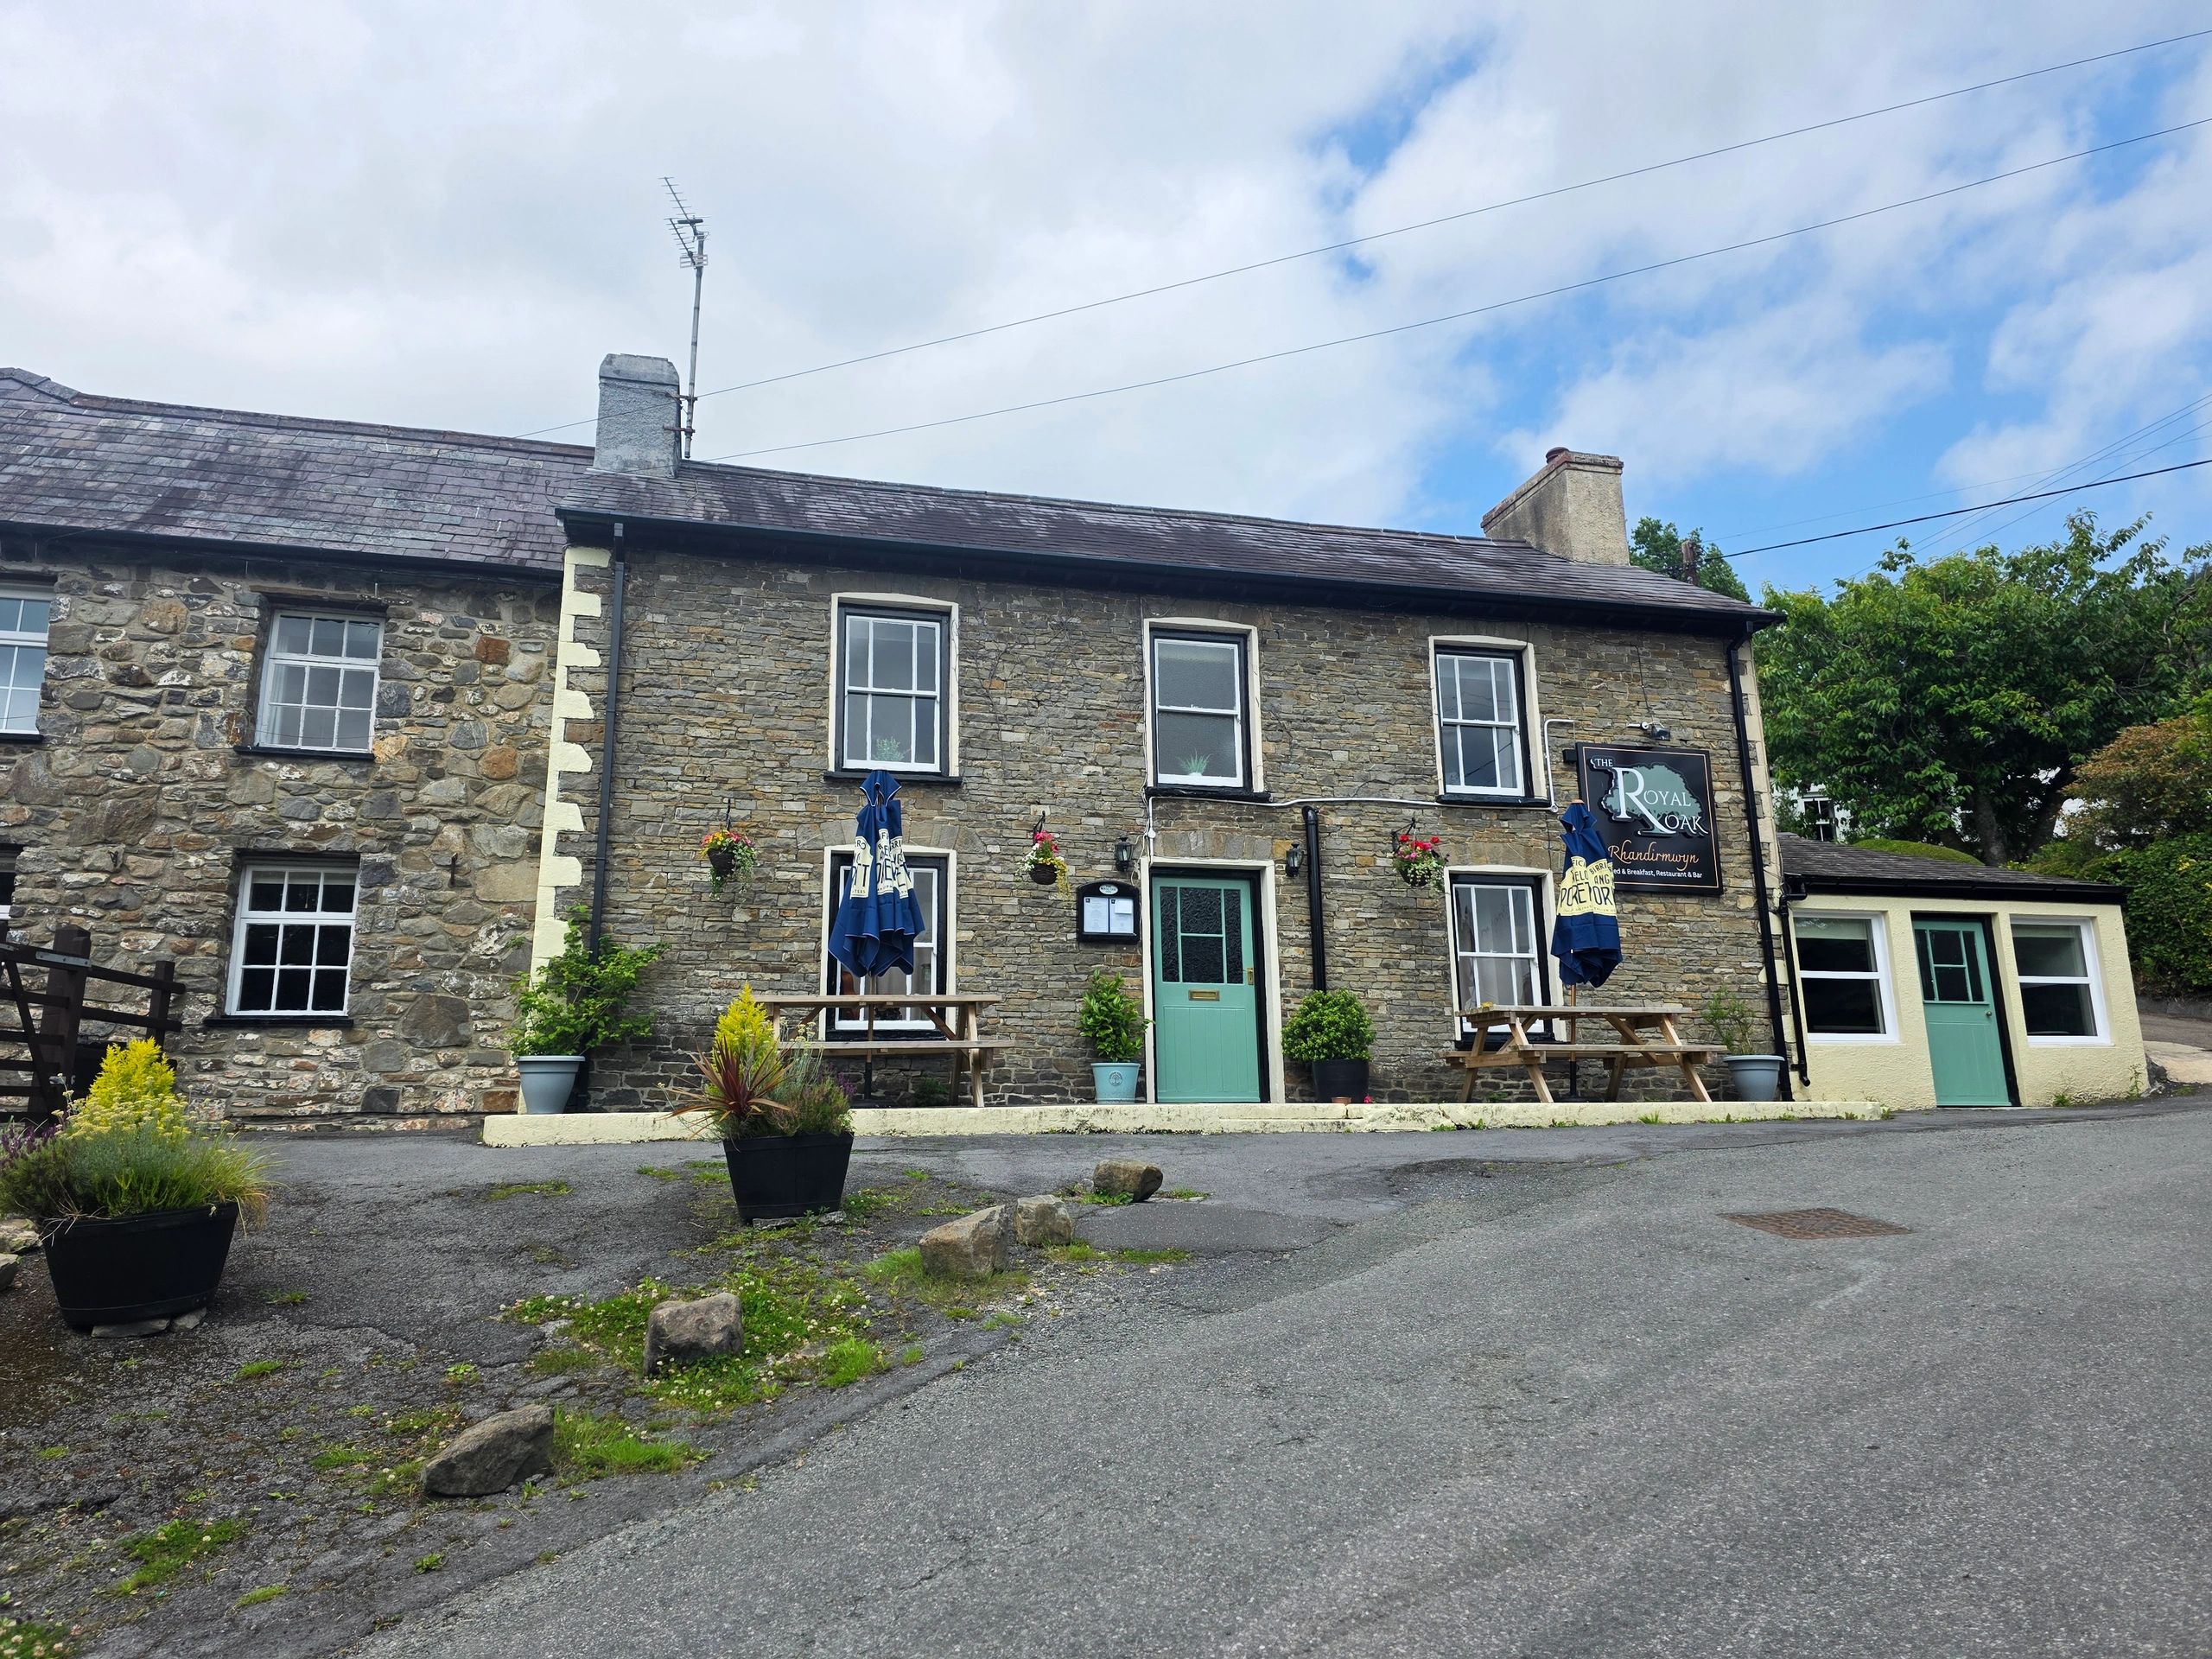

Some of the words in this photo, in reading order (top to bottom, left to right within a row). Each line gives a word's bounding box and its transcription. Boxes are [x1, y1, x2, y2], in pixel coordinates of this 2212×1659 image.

[1596, 758, 1613, 767] THE
[1612, 766, 1692, 834] ROYAL
[1664, 814, 1709, 835] OAK
[1608, 840, 1700, 871] Rhandirmwyn
[1627, 868, 1656, 877] Breakfast,
